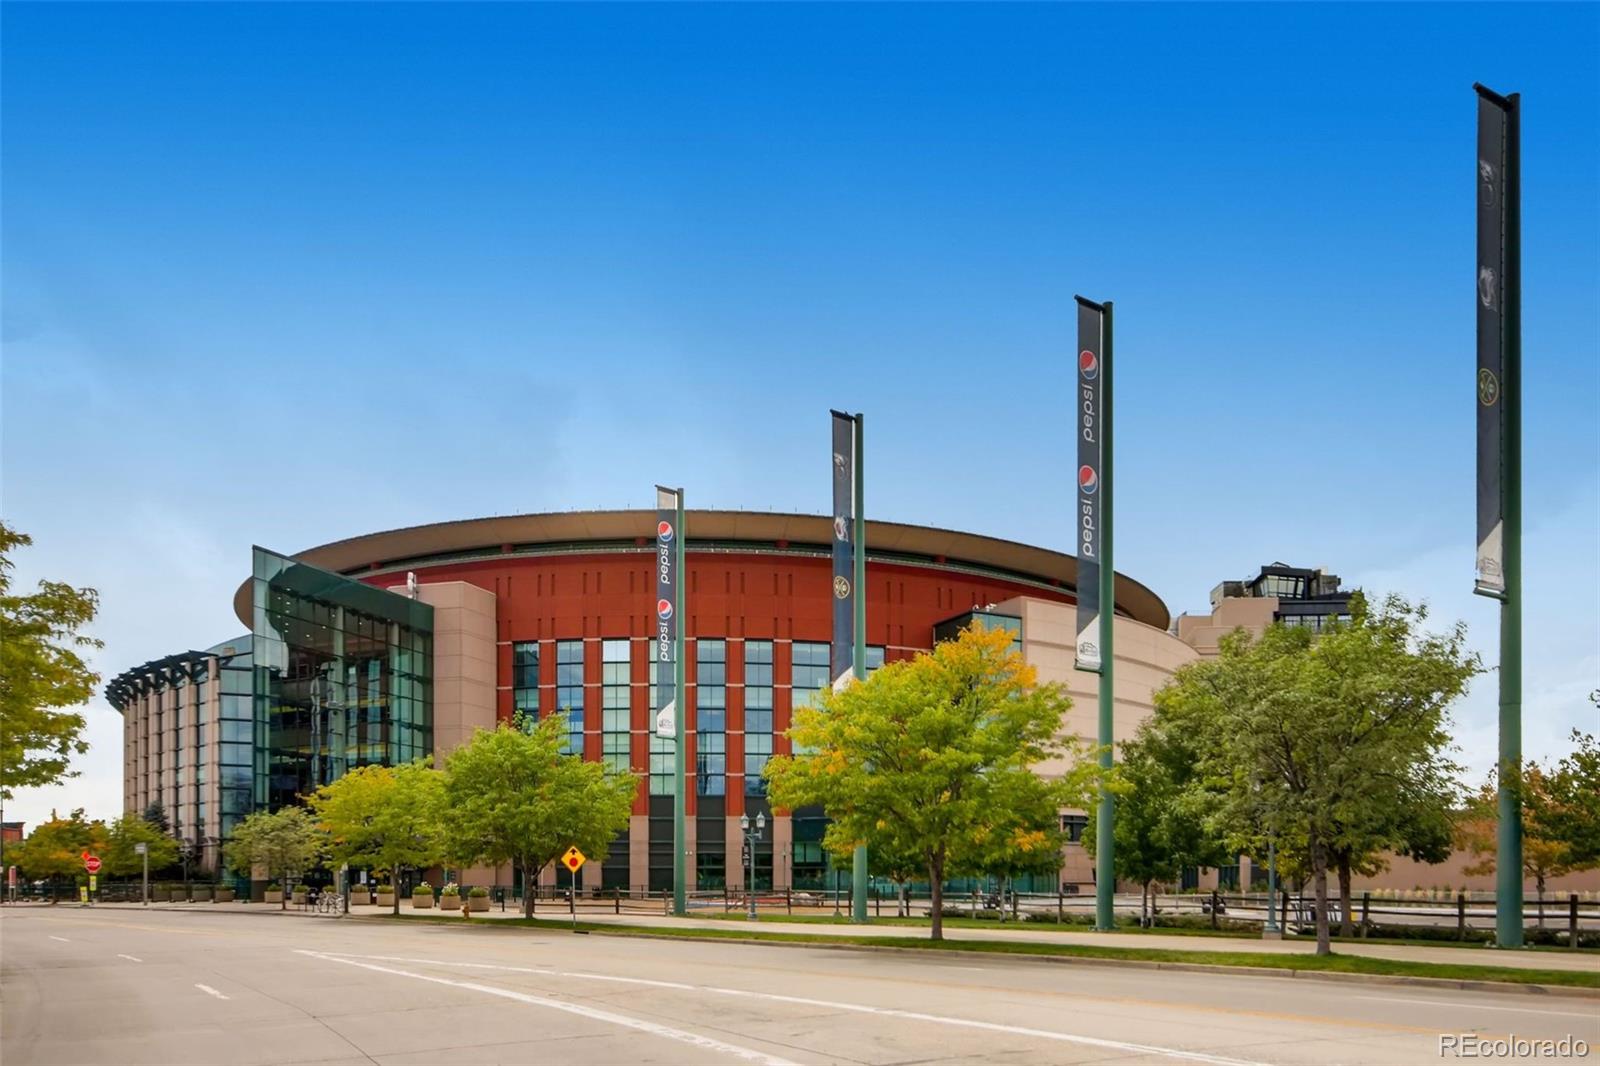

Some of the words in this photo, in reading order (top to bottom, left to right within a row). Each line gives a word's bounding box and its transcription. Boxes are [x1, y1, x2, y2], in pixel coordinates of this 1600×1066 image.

[1083, 384, 1095, 443] pepsi
[1082, 499, 1095, 557] pepsi
[660, 544, 670, 584] pepsi
[660, 622, 670, 661] pepsi
